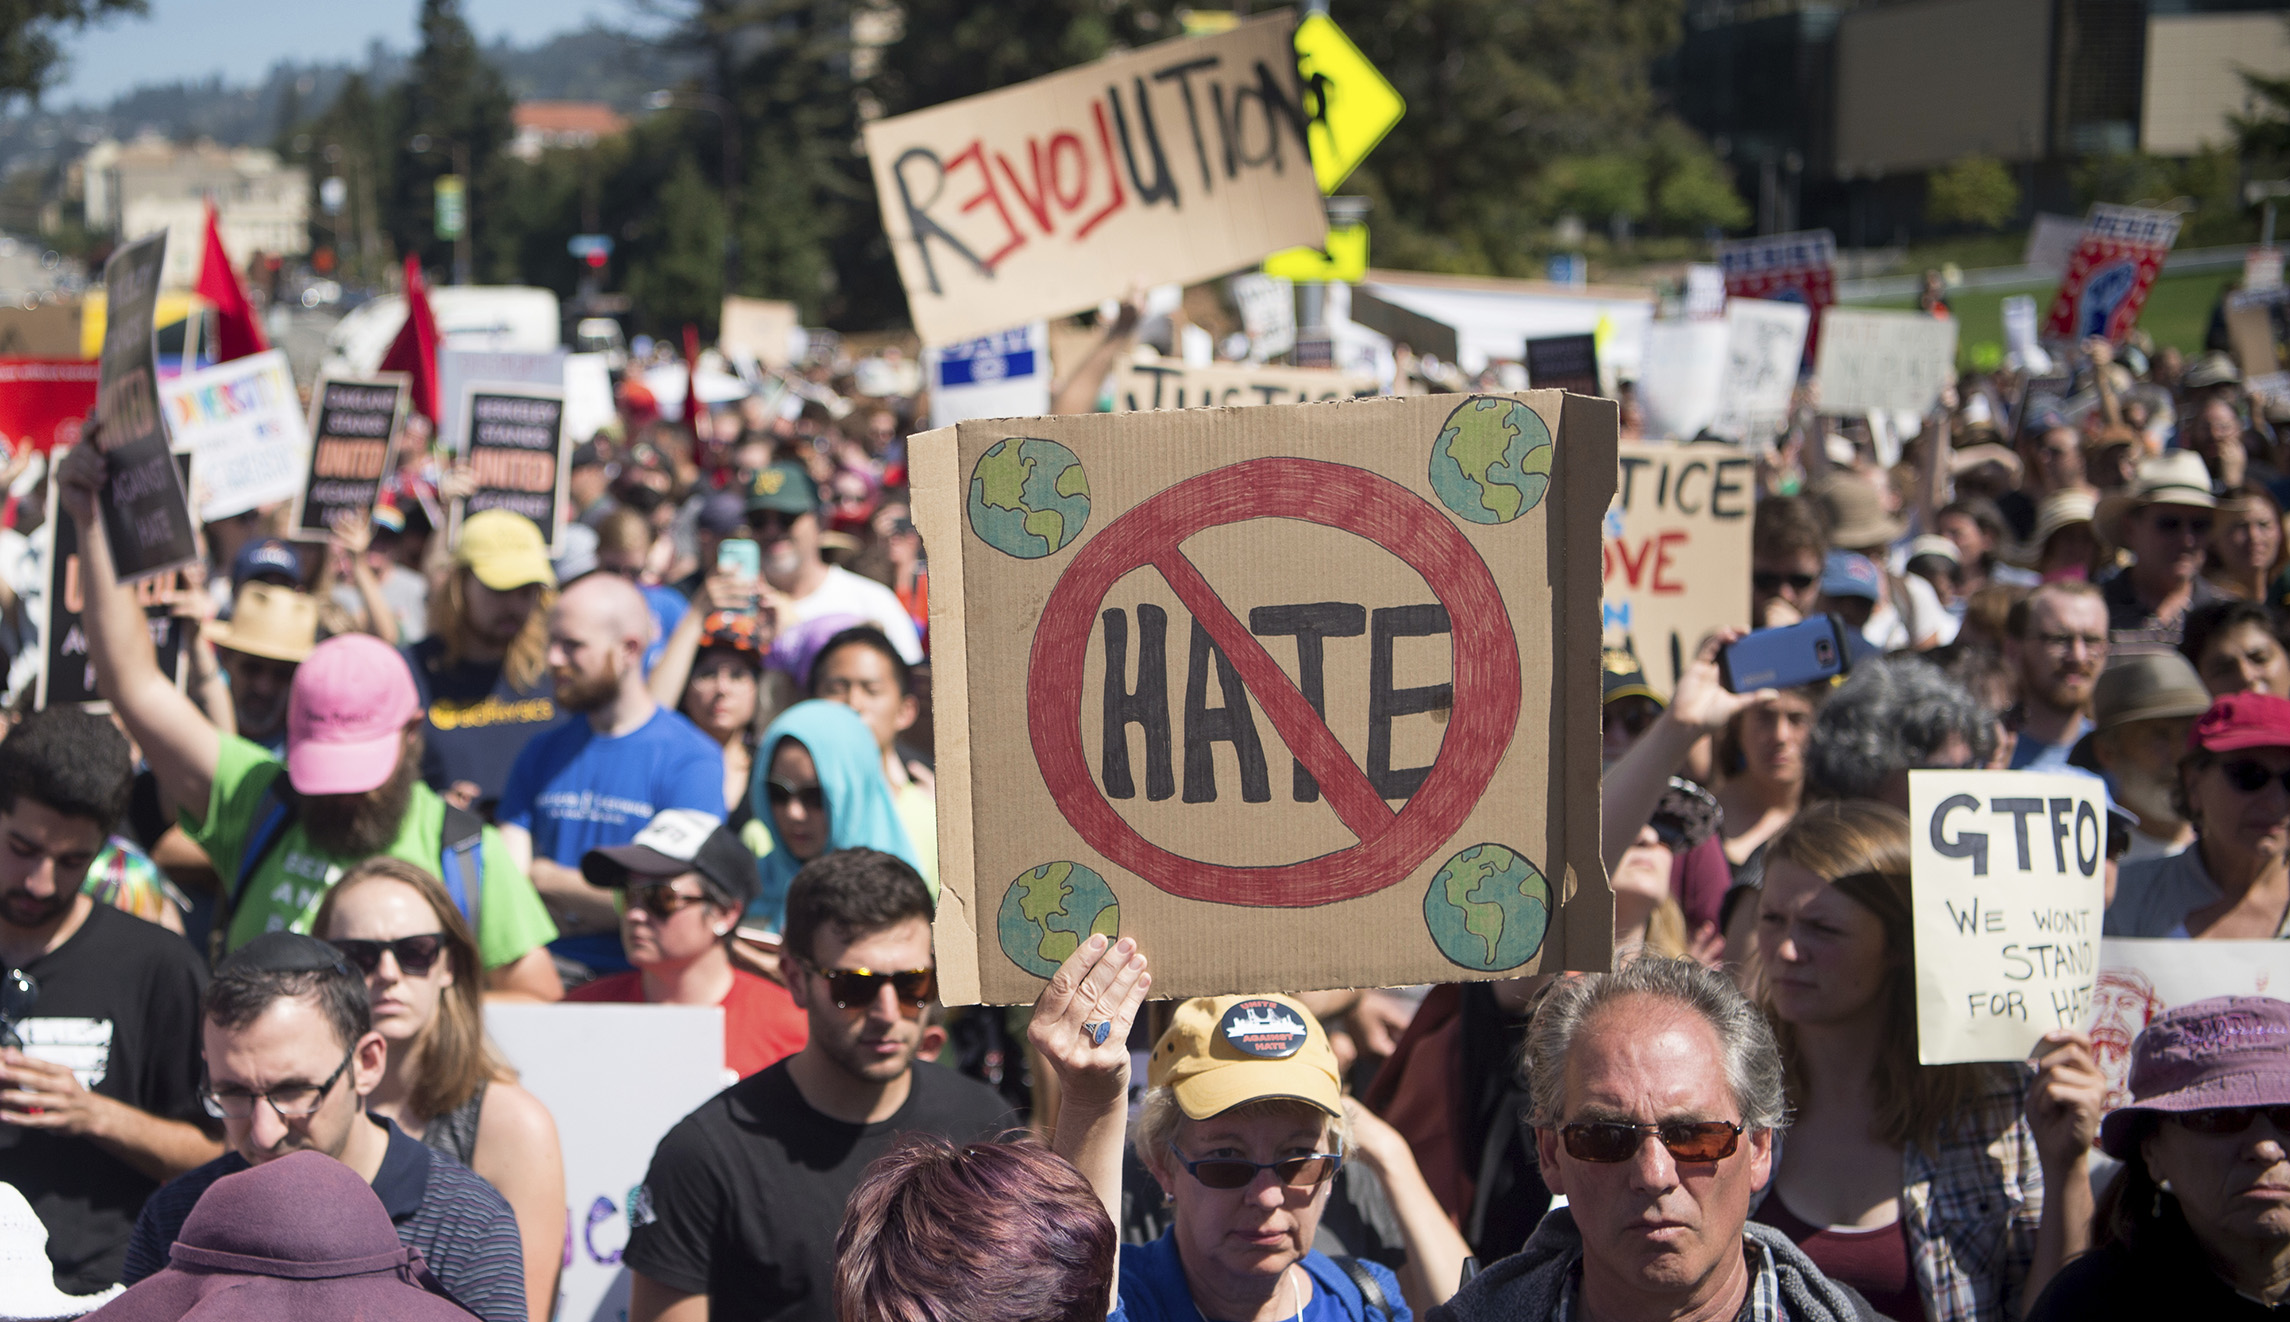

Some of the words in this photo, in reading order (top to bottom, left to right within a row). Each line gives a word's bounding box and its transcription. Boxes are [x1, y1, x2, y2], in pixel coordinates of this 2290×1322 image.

[314, 435, 387, 481] UNITED
[470, 446, 556, 493] UNITED
[1102, 602, 1454, 804] HATE
[1929, 793, 2099, 878] GTFO
[1945, 897, 2007, 936] WE
[2032, 907, 2091, 936] WONT
[2002, 941, 2093, 981] STAND
[1240, 1001, 1278, 1010] UNITE
[1968, 990, 2028, 1022] FOR
[1243, 1033, 1294, 1043] AGAINST
[1254, 1042, 1287, 1051] HATE
